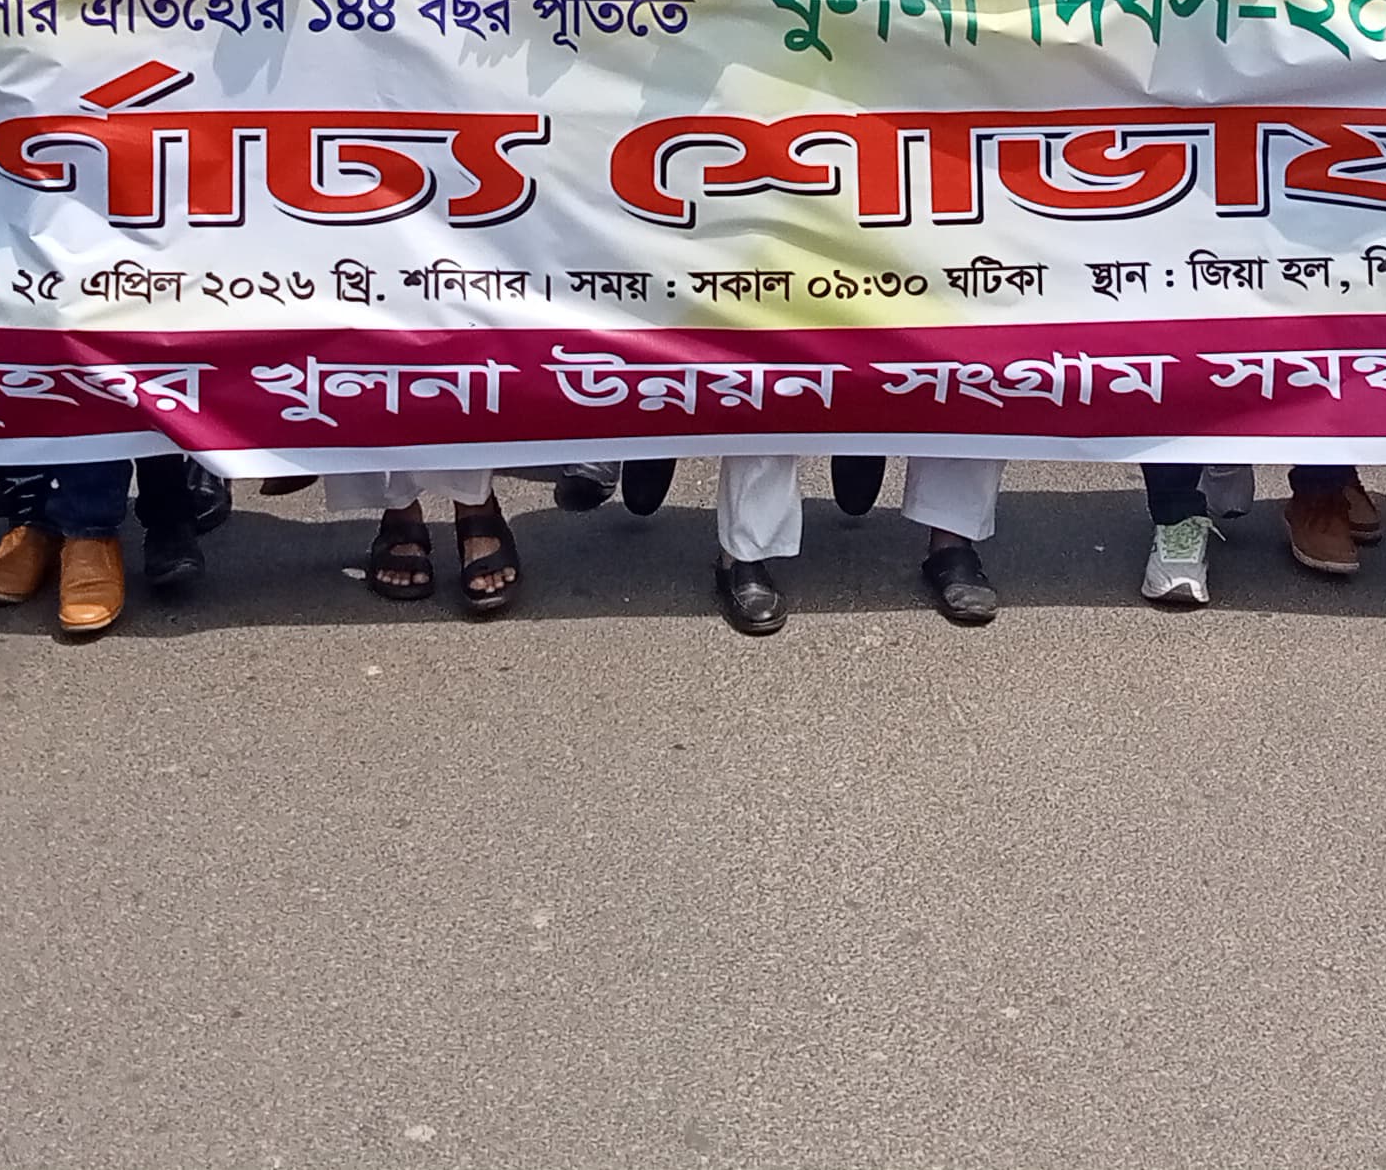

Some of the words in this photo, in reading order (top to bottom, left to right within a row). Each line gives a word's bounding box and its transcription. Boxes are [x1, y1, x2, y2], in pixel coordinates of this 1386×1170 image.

[13, 269, 65, 303] ২৫
[81, 259, 187, 304] এপ্রিল
[202, 270, 316, 305] ২০২৬
[331, 258, 385, 305] খ্রি.
[566, 270, 653, 302] সময়
[689, 269, 794, 302] সকাল
[807, 269, 928, 300] ০৯:৩০
[942, 255, 1049, 298] ঘটিকা
[1085, 260, 1151, 302] স্থান
[1185, 249, 1268, 291] জিয়া
[251, 355, 520, 427] খুলনা
[540, 344, 853, 416] উন্নয়ন
[868, 350, 1181, 408] সংগ্রাম
